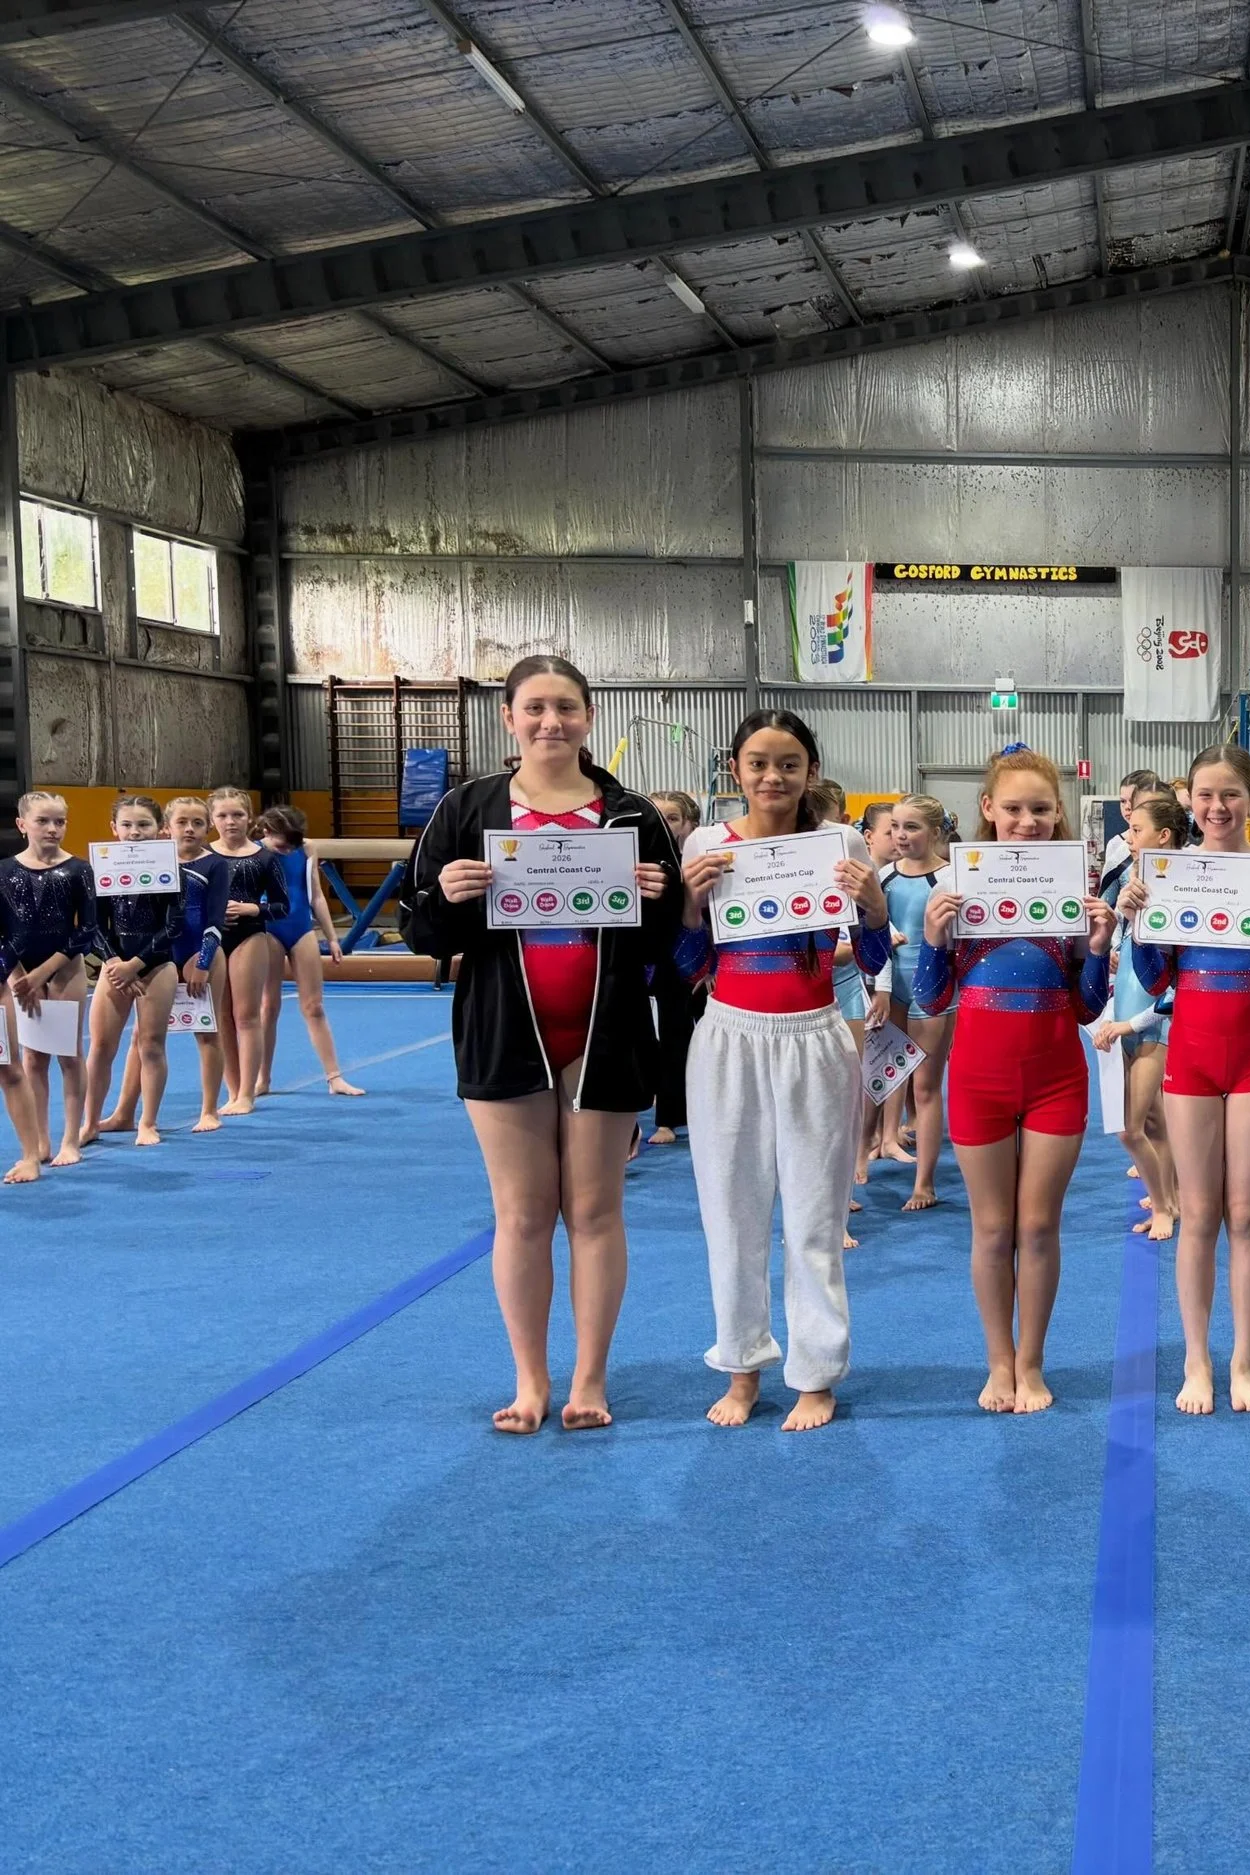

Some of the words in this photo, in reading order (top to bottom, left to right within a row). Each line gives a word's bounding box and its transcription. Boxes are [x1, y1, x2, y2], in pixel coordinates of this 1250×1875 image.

[893, 564, 961, 579] GOSFORD
[970, 565, 1077, 581] GYMNASTICS
[1153, 615, 1165, 647] Beijing
[809, 614, 818, 665] 2003
[1155, 648, 1164, 671] 2008
[551, 854, 572, 862] 2026
[526, 867, 558, 875] Central
[559, 866, 583, 874] Coast
[584, 866, 602, 875] Cup
[767, 860, 786, 870] 2026
[744, 874, 774, 884] Central
[774, 872, 797, 881] Coast
[798, 868, 815, 878] Cup
[988, 876, 1015, 884] Central
[1039, 876, 1054, 884] Cup
[1173, 885, 1200, 893] Central
[1201, 886, 1223, 894] Coast
[1223, 887, 1239, 895] Cup
